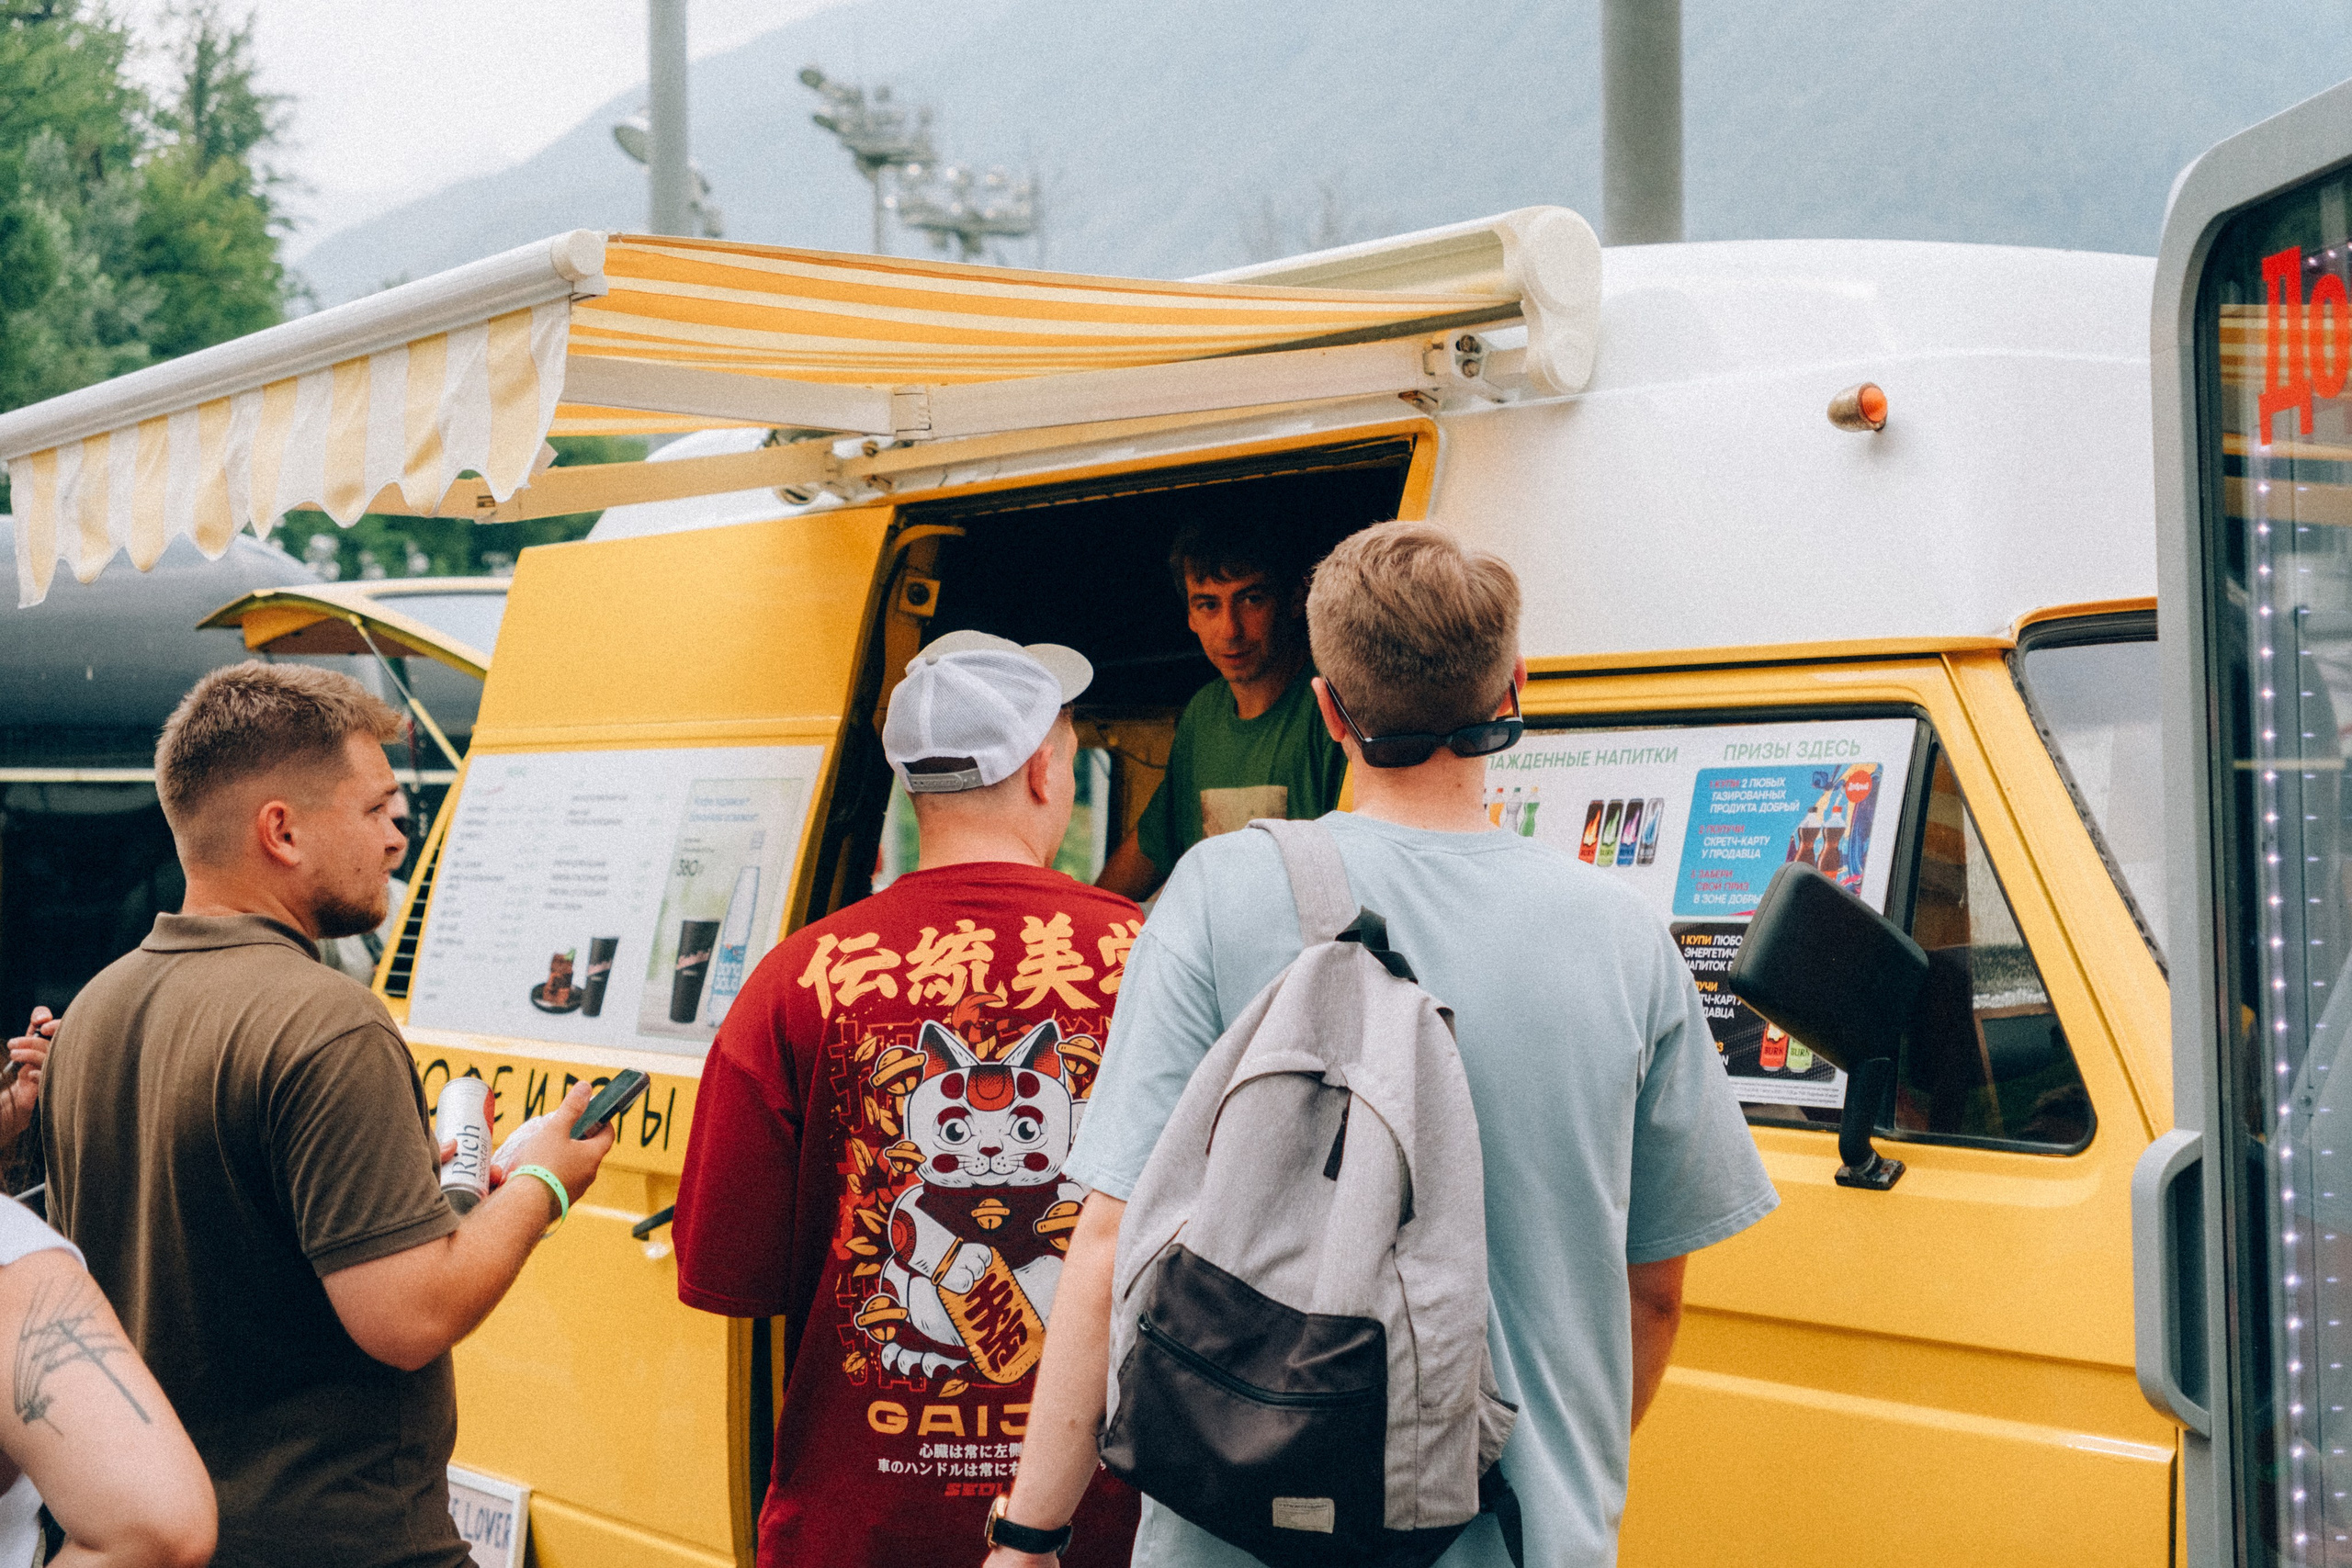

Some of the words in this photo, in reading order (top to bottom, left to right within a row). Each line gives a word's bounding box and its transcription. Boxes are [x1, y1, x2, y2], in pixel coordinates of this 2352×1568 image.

[2257, 244, 2352, 446] До
[1724, 741, 1792, 761] ПРИЗЫ
[1795, 739, 1862, 760] ЗДЕСЬ
[1487, 750, 1591, 772] ЛАЖДЕННЫЕ
[1595, 746, 1679, 765] НАПИТКИ
[1714, 779, 1740, 789] КУПИ
[1741, 779, 1747, 788] 2
[1748, 777, 1787, 788] ЛЮБЫХ
[1712, 789, 1787, 801] ГАЗИРОВАННЫХ
[1709, 802, 1758, 815] ПРОДУКТА
[1758, 799, 1801, 814] ДОБРЫЙ
[1698, 825, 1704, 834] 2
[1706, 824, 1745, 834] ПОЛУЧИ
[1703, 836, 1771, 847] СКРЕТЧ-КАРТУ
[1702, 849, 1709, 859] У
[1709, 848, 1761, 860] ПРОДАВЦА
[1698, 869, 1734, 879] ЗАБЕРИ
[1696, 880, 1722, 891] СВОЙ
[1724, 882, 1750, 891] ПРИЗ
[1693, 894, 1701, 904] В
[1702, 894, 1727, 904] ЗОНЕ
[1728, 894, 1763, 905] ДОБРЫ
[1680, 935, 1685, 945] 1
[1686, 935, 1713, 945] КУПИ
[1713, 935, 1743, 946] ЛЮБО
[1695, 980, 1718, 992] ЛУЧИ
[1703, 1007, 1735, 1020] ДАВЦА
[1763, 1045, 1784, 1055] BURN
[1790, 1046, 1811, 1056] BURN
[451, 1123, 481, 1178] Rich
[479, 1136, 489, 1184] cocktail
[867, 1399, 1034, 1438] GAIJ
[919, 1442, 1023, 1461] 心臓は常に左側
